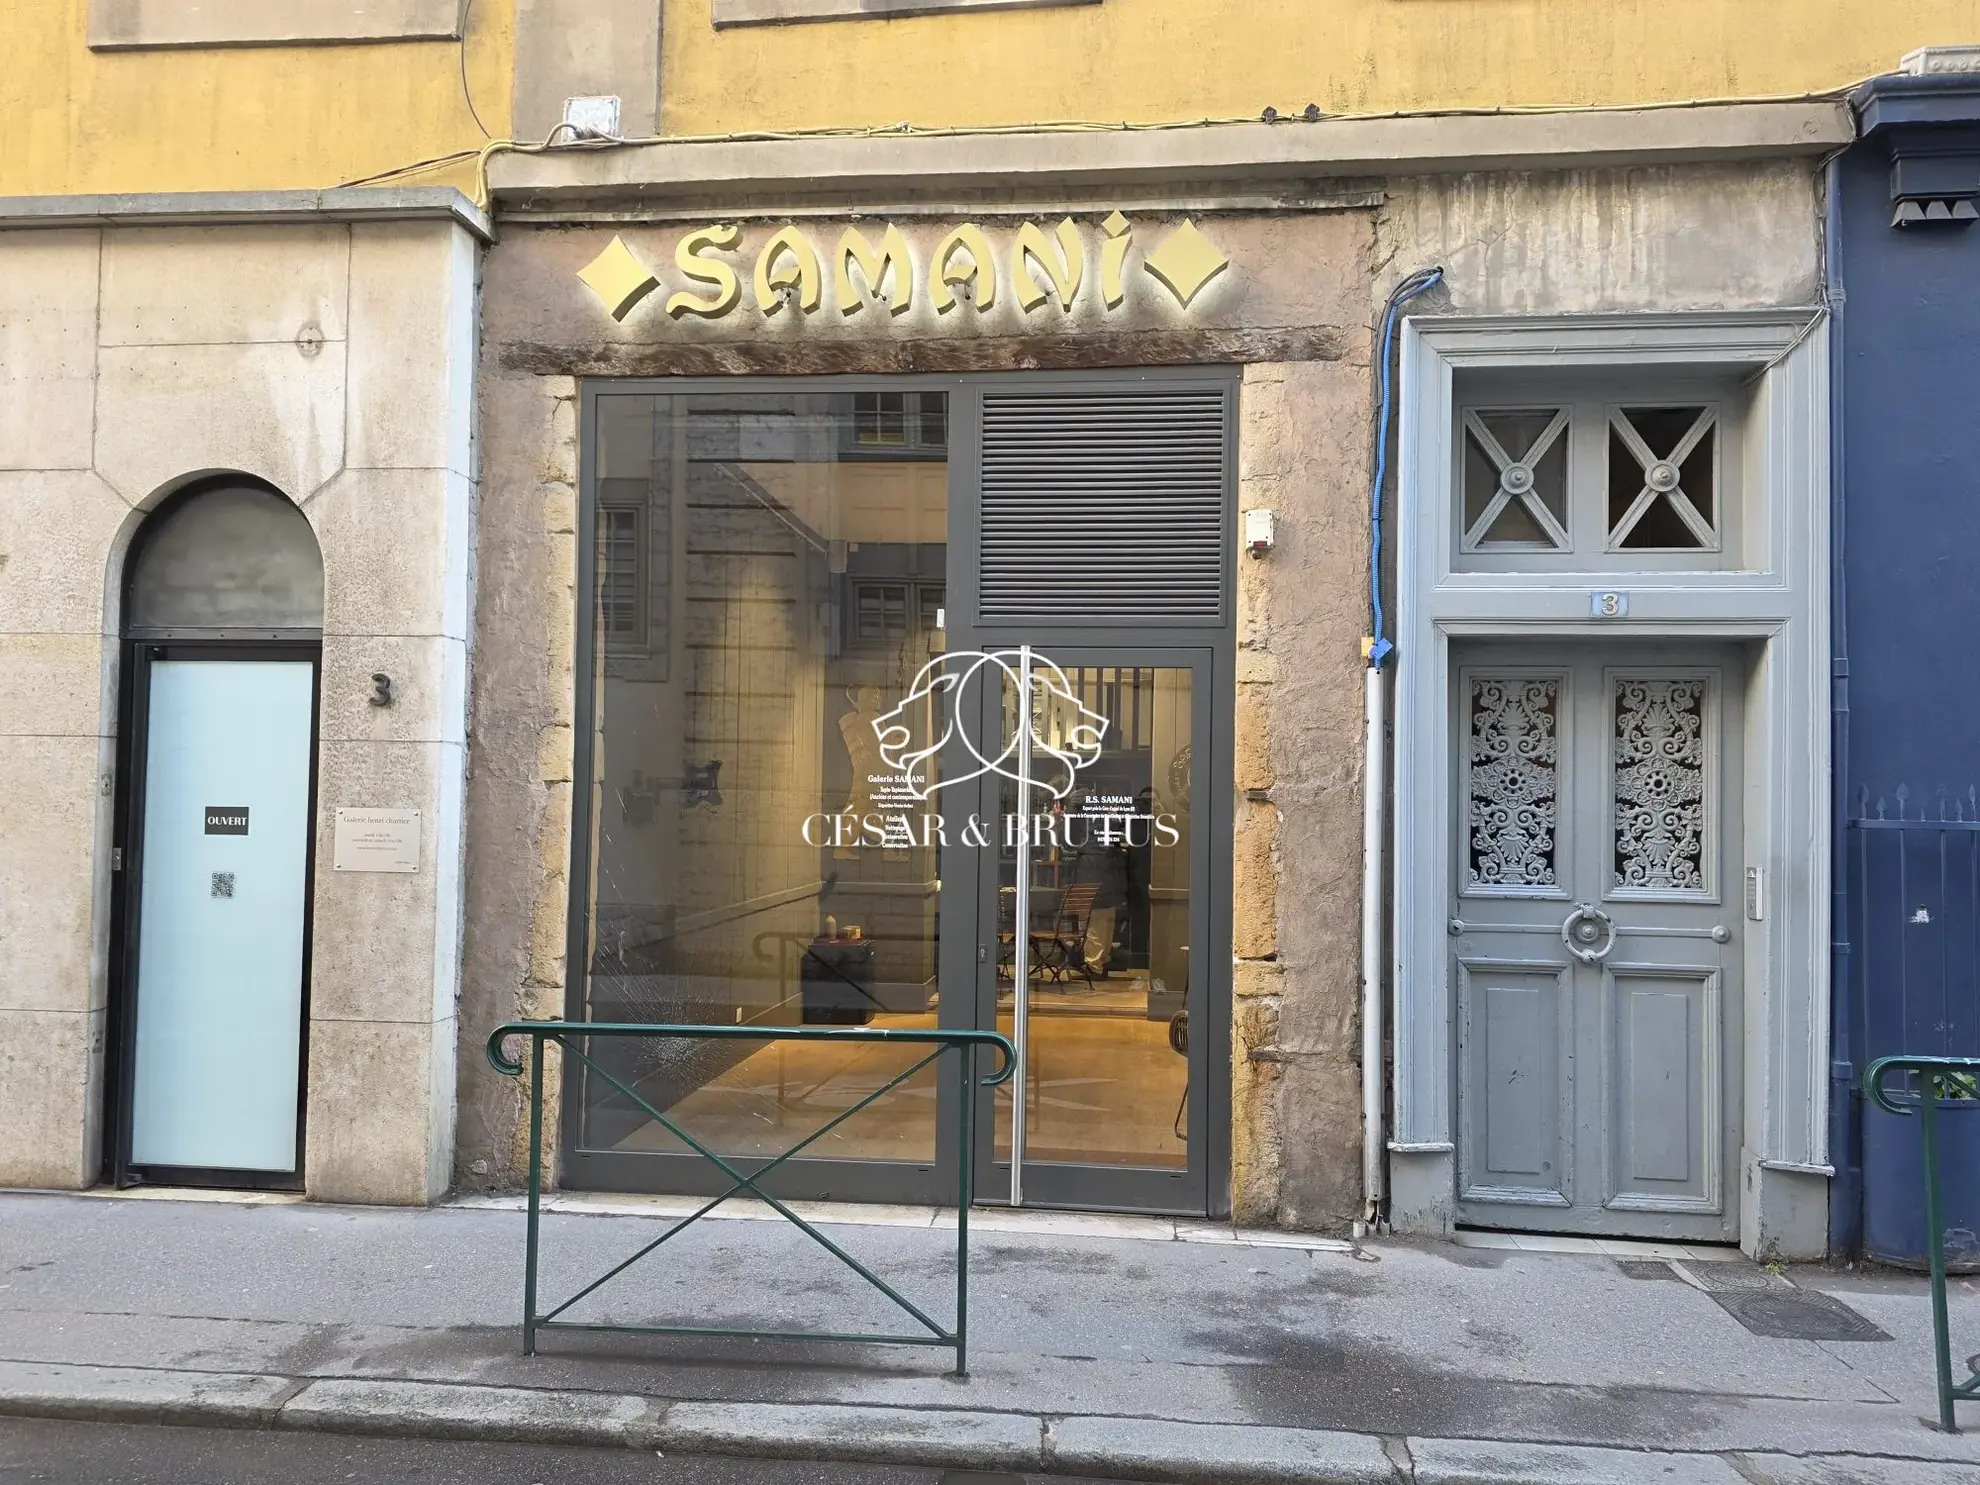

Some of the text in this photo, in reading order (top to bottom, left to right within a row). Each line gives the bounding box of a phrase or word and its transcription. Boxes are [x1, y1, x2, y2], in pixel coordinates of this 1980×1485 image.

[1602, 592, 1619, 616] 3
[369, 673, 391, 707] 3
[868, 774, 893, 783] Galerie
[1101, 796, 1132, 804] SAMANI
[207, 816, 247, 826] OUVERT
[343, 816, 366, 824] Galerie
